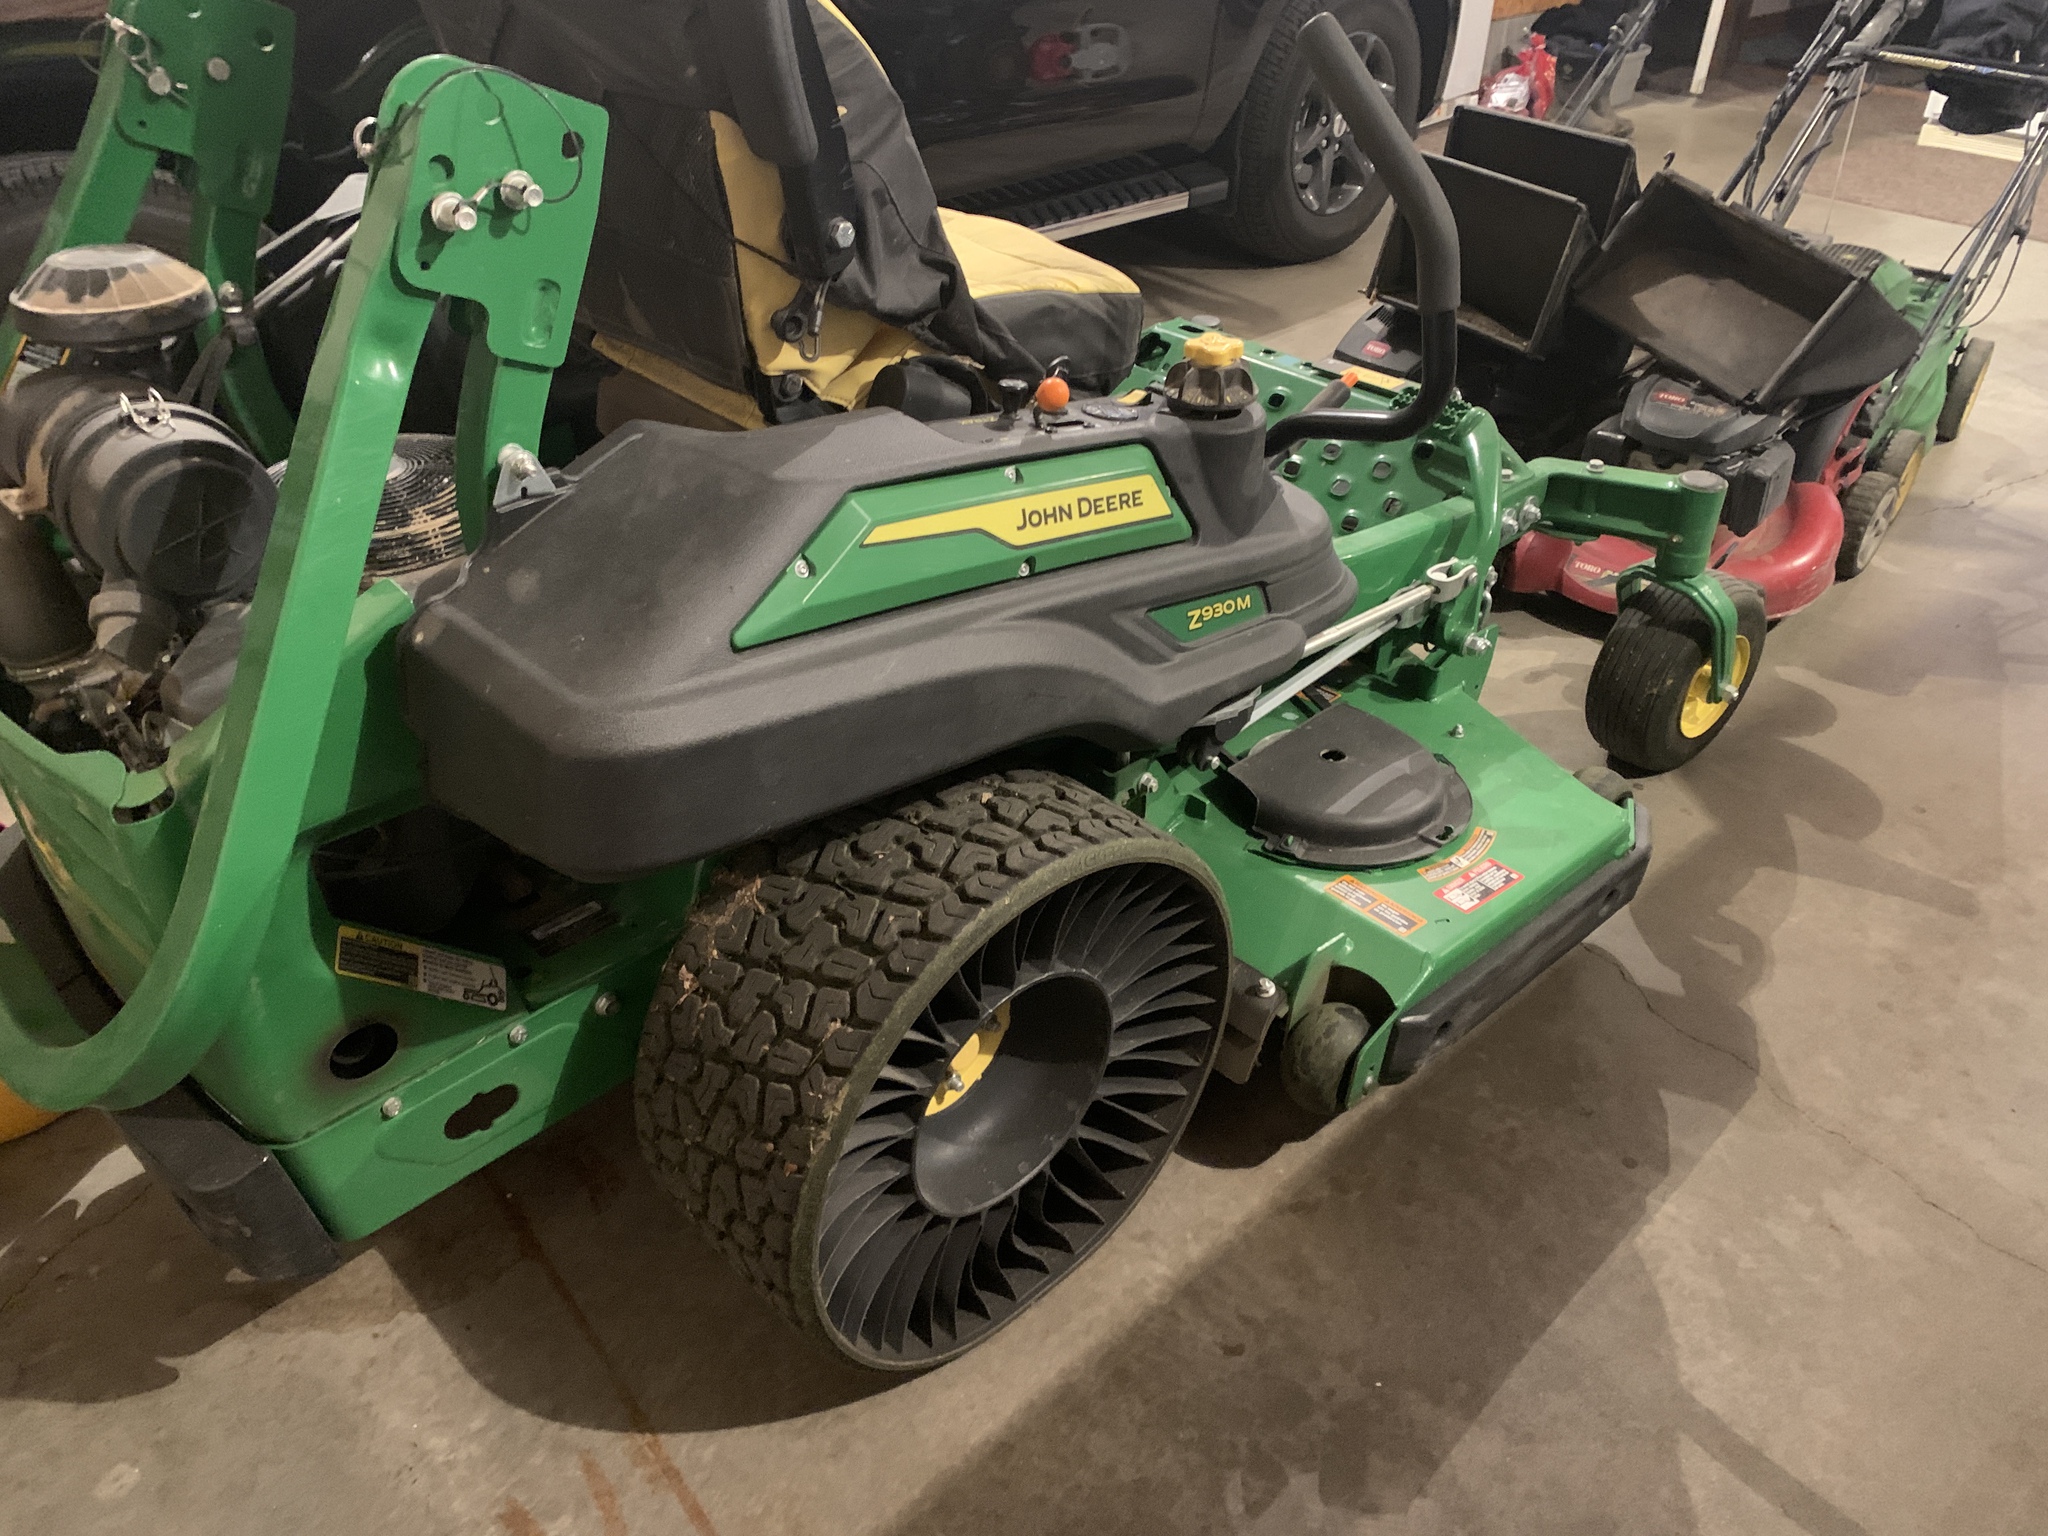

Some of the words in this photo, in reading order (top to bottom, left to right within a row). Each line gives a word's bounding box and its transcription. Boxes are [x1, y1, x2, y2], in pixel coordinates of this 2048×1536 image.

[1016, 503, 1073, 531] JOHN
[1077, 489, 1144, 518] DEERE
[1575, 560, 1601, 574] TORO
[1187, 594, 1251, 631] Z930M
